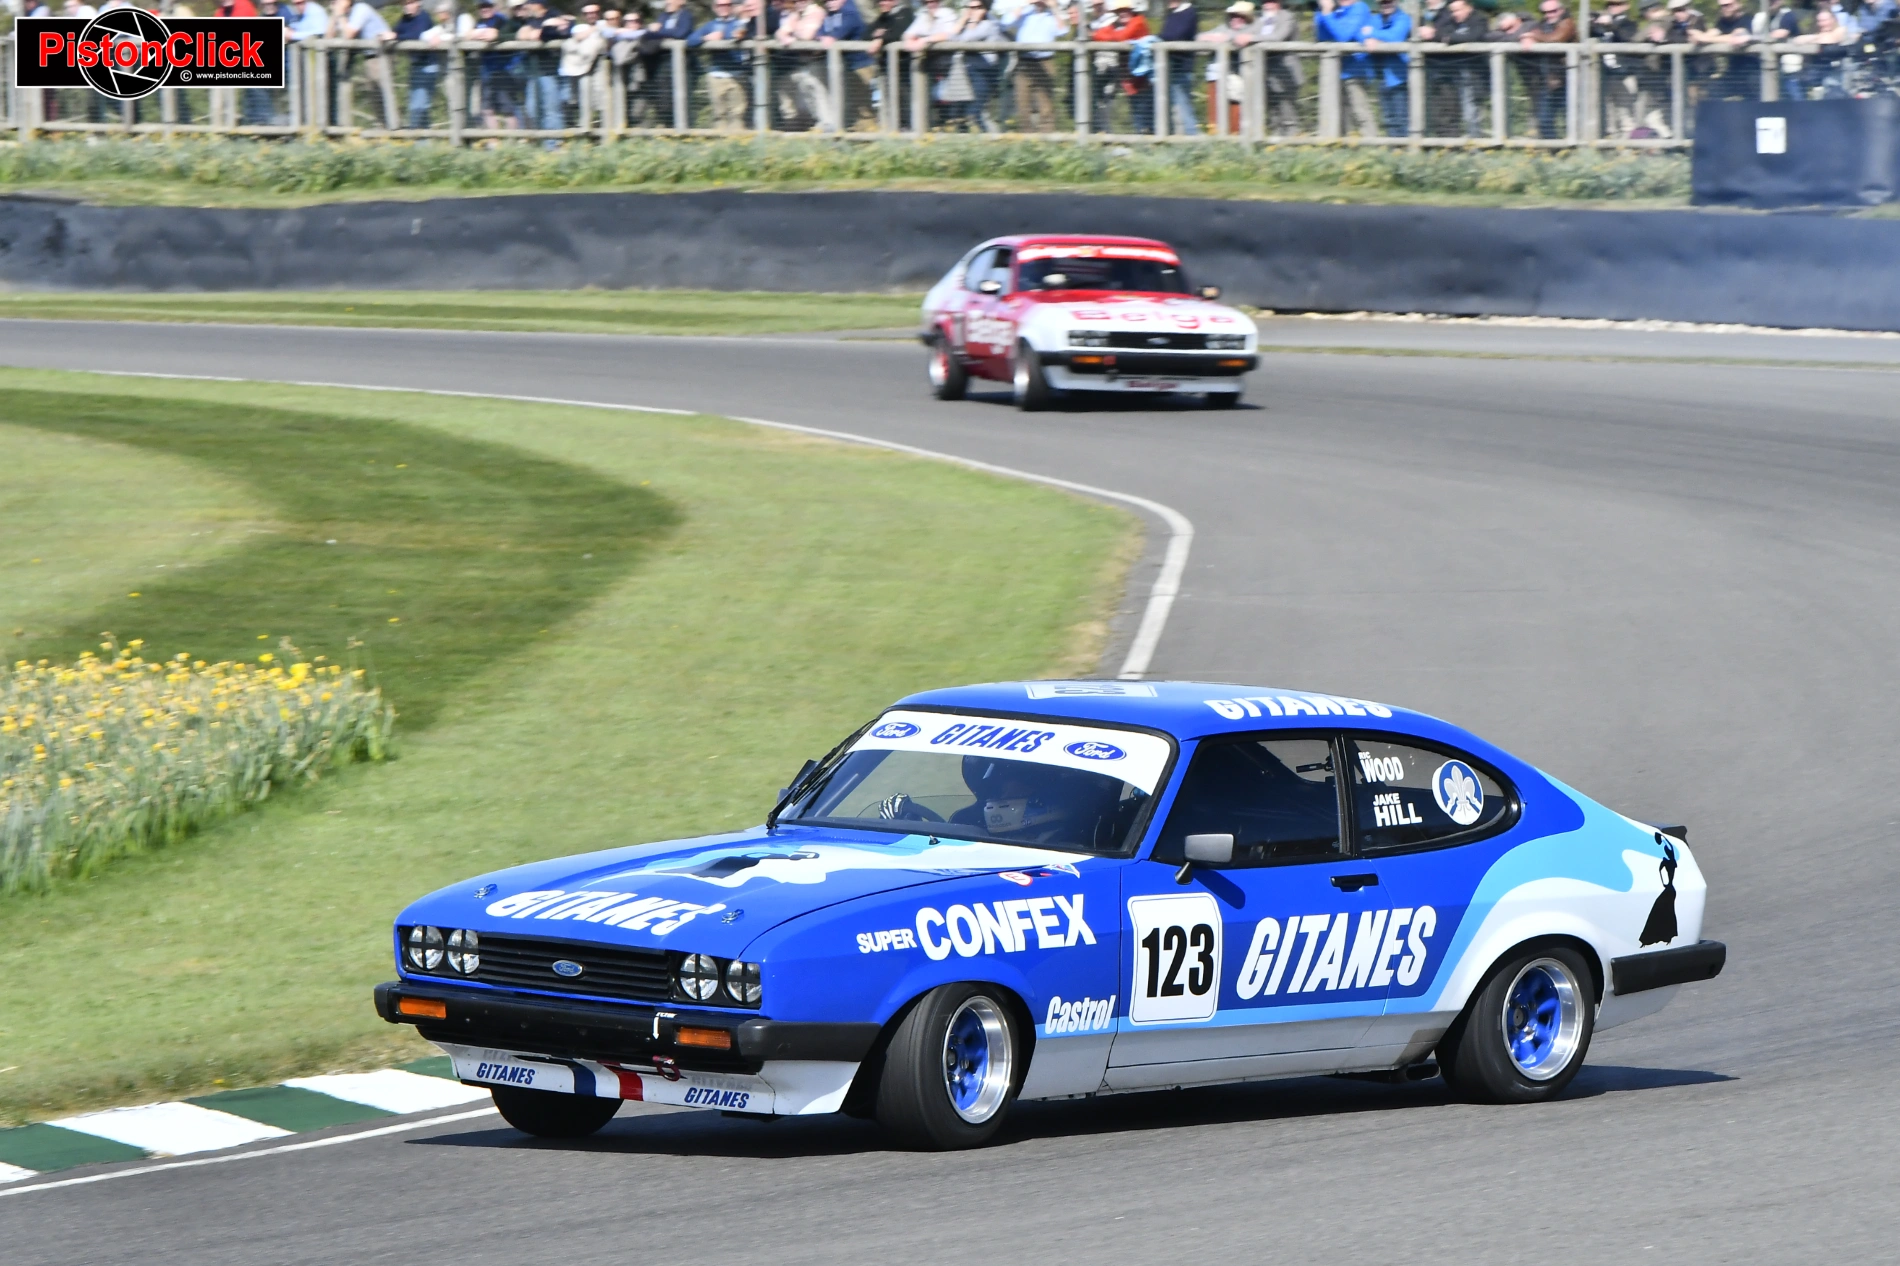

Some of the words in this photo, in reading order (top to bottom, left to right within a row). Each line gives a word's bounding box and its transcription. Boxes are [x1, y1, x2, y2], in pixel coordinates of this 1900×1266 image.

[1204, 696, 1393, 720] GITANES
[878, 722, 907, 738] Ford
[930, 723, 1055, 753] GITANES
[1074, 742, 1116, 760] Ford
[1360, 757, 1404, 783] WOOD
[1373, 793, 1401, 806] JAKE
[1374, 803, 1423, 827] HILL
[486, 890, 727, 936] GITANES
[856, 928, 918, 954] SUPER
[915, 894, 1097, 961] CONFEX
[1142, 923, 1215, 998] 123
[1236, 905, 1437, 1000] GITANES
[1045, 995, 1117, 1035] Castrol
[476, 1062, 536, 1085] GITANES
[684, 1087, 750, 1109] GITANES
